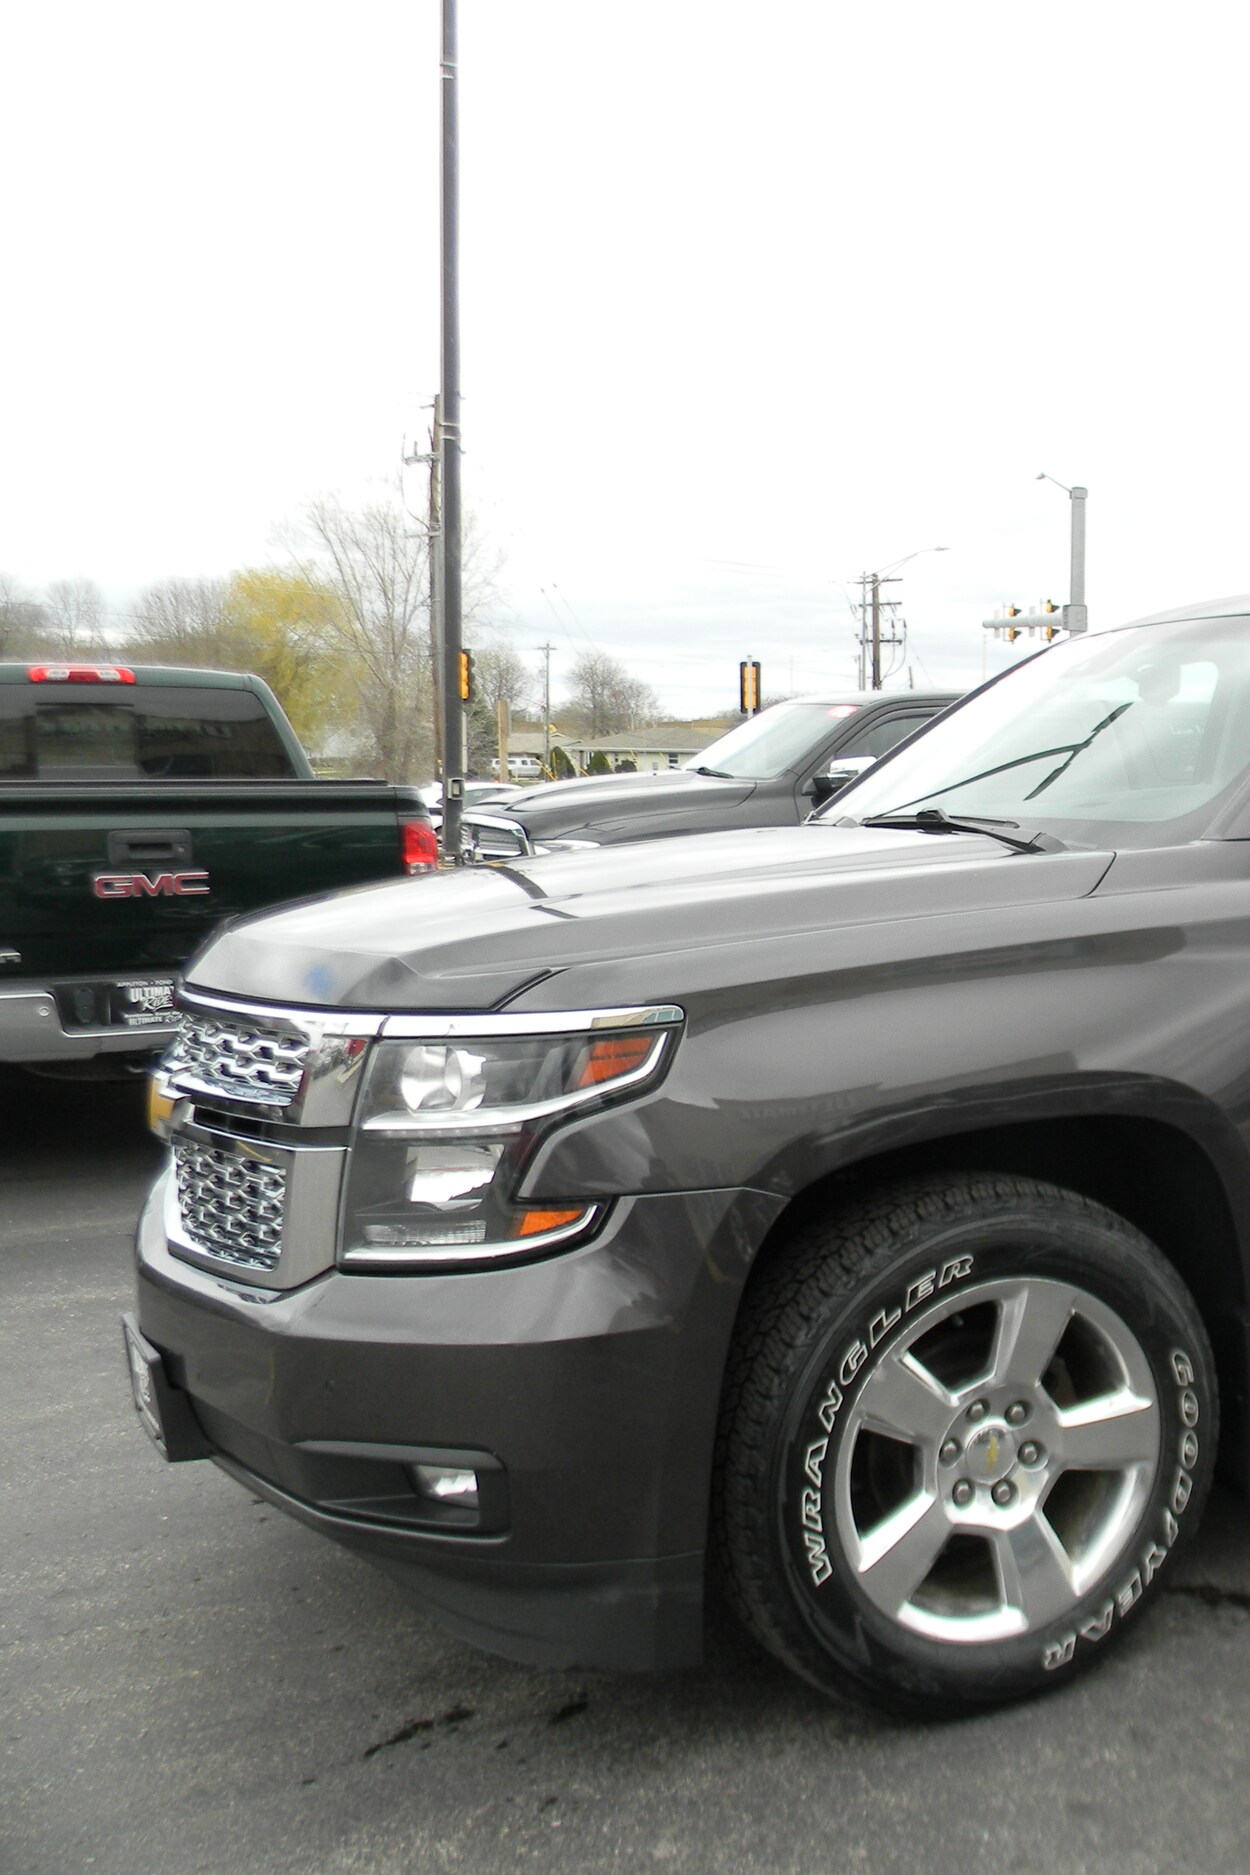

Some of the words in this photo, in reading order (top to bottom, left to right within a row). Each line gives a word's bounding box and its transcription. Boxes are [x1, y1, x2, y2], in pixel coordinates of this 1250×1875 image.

[95, 871, 211, 898] GMC
[802, 1254, 974, 1588] WRANGLER
[1042, 1349, 1200, 1671] GOODYEAR
